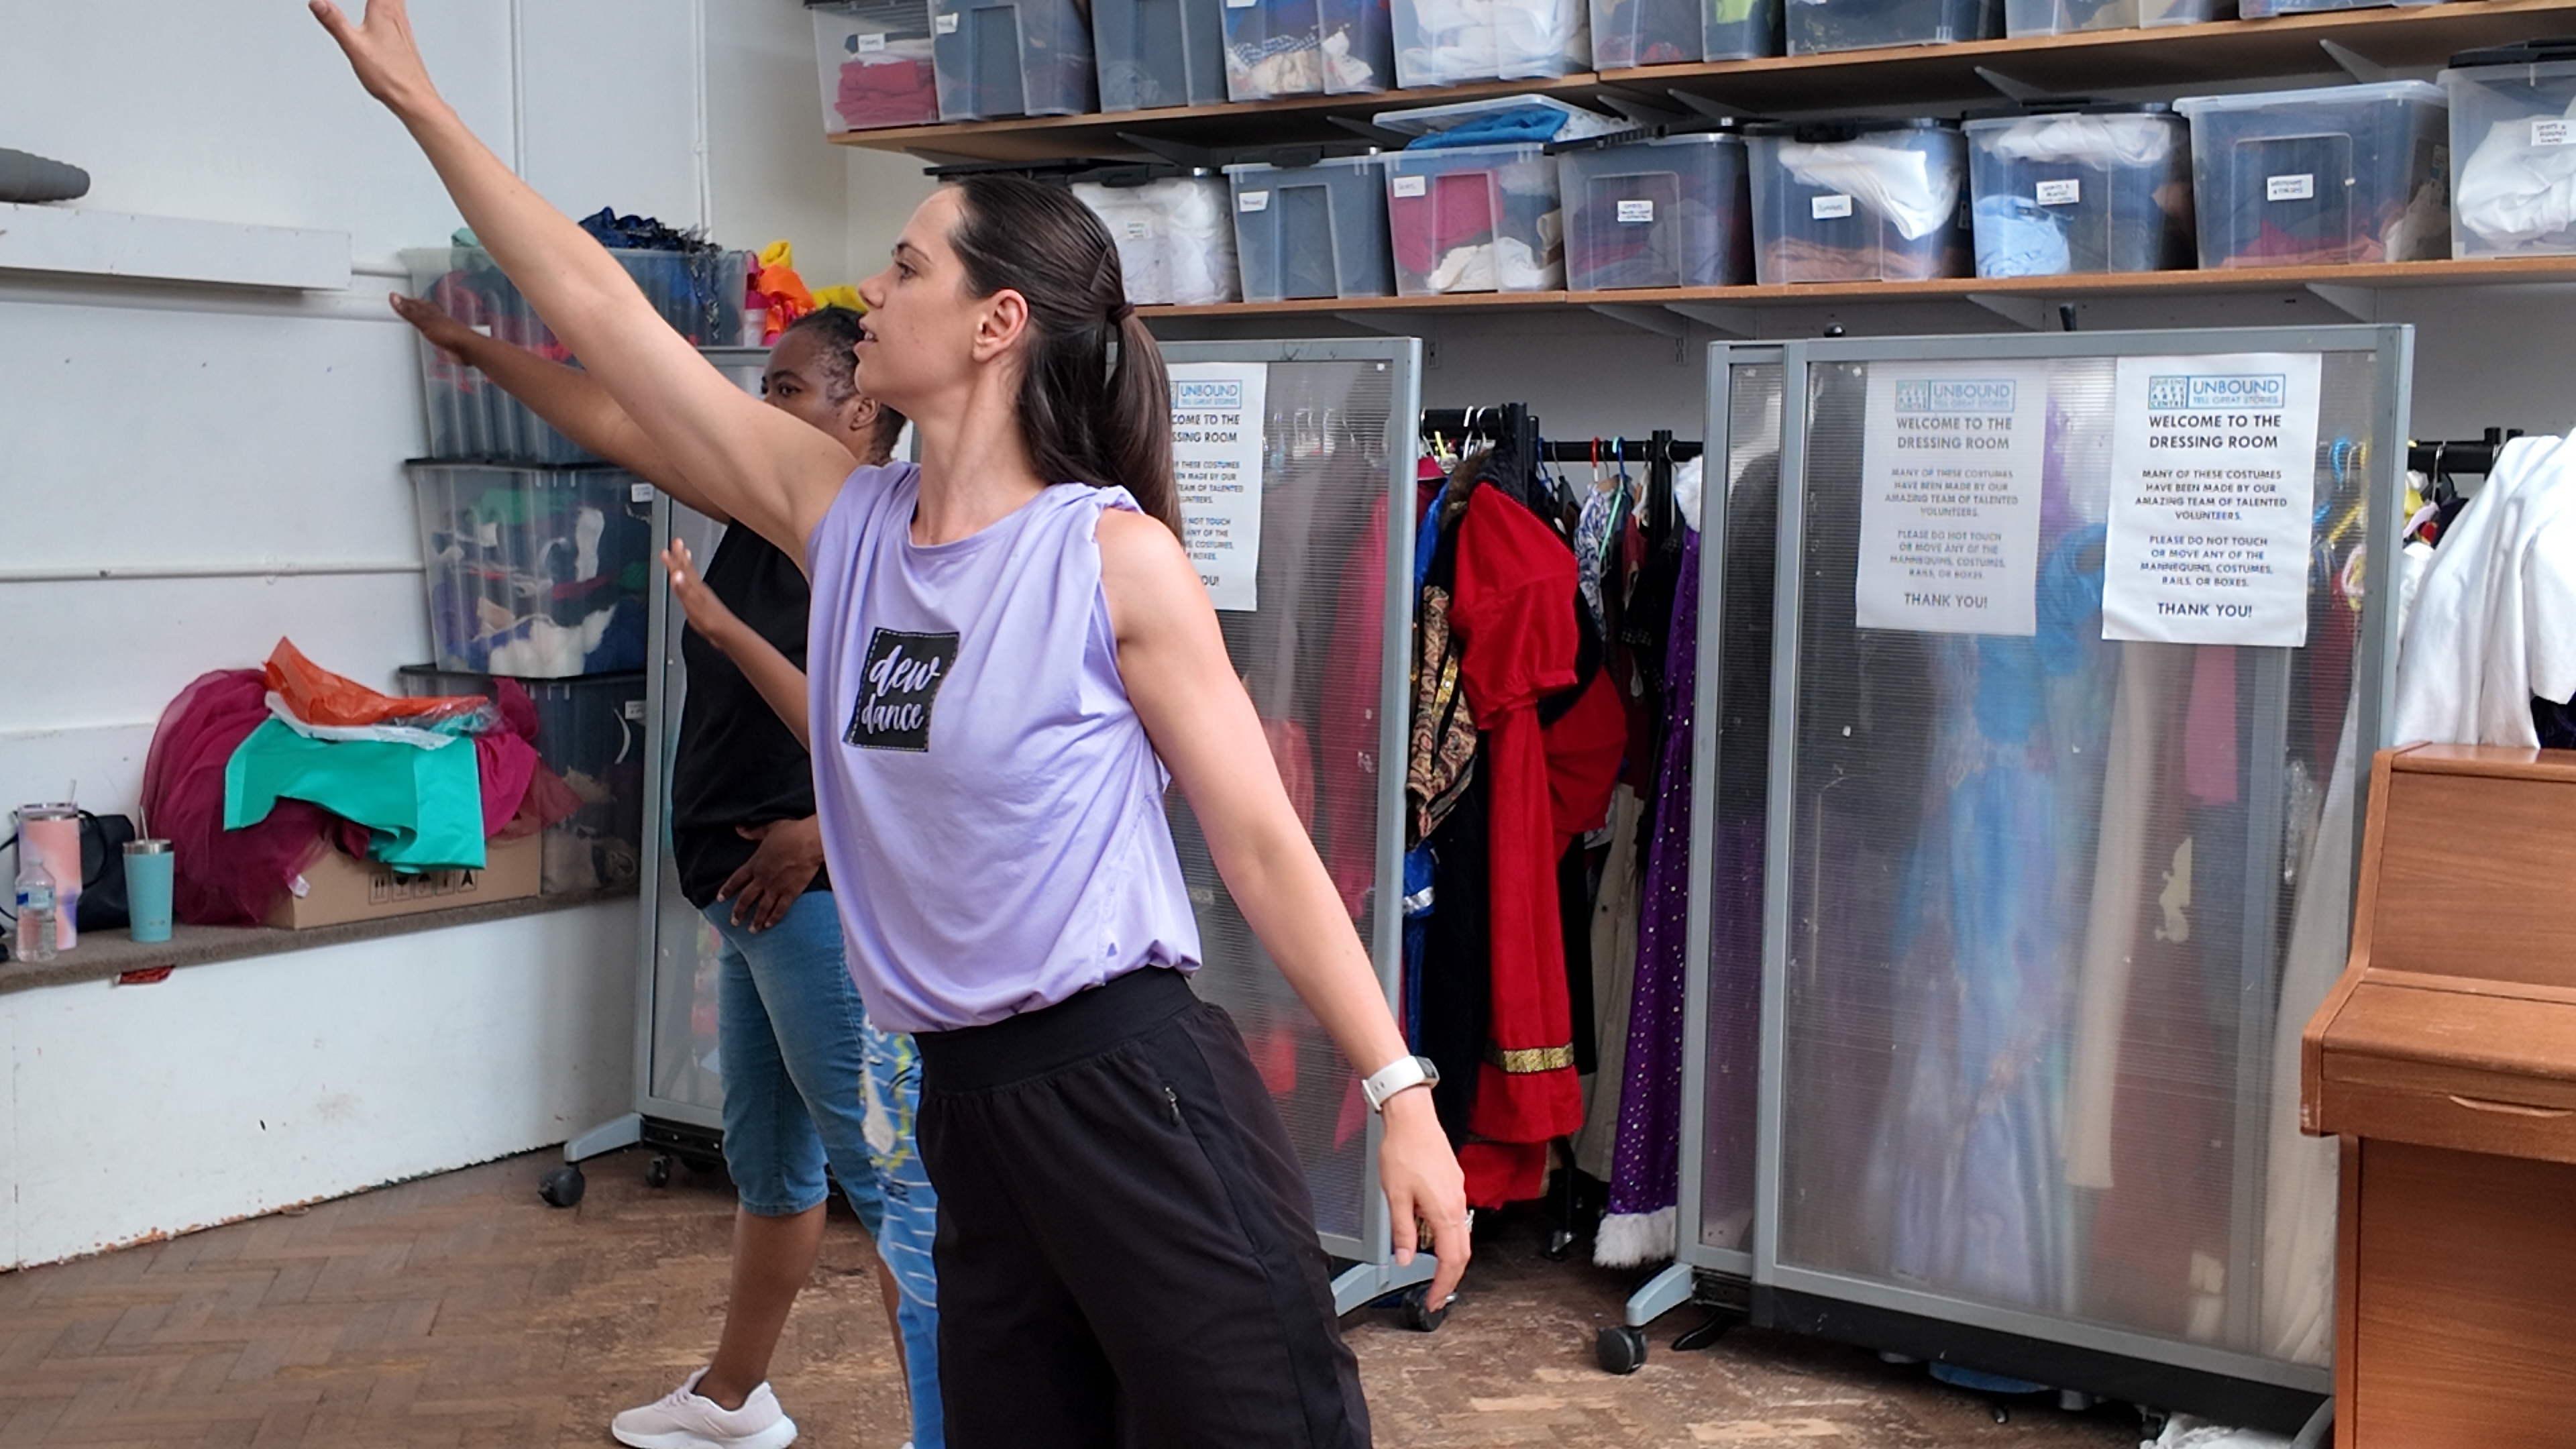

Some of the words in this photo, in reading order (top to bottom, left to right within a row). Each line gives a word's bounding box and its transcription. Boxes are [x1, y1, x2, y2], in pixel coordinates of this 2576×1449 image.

[1180, 385, 1237, 396] UNBOUND
[1934, 385, 2010, 397] UNBOUND
[2194, 380, 2279, 394] UNBOUND
[1172, 415, 1201, 425] COME
[1204, 415, 1218, 425] TO
[1222, 415, 1240, 425] THE
[1897, 418, 1960, 430] WELCOME
[1966, 418, 1983, 430] TO
[1987, 418, 2012, 430] THE
[2149, 415, 2222, 427] WELCOME
[2228, 415, 2247, 427] TO
[2254, 415, 2282, 427] THE
[1172, 432, 1201, 442] SSING
[1204, 432, 1237, 442] ROOM
[2150, 436, 2223, 448] DRESSING
[2229, 436, 2277, 448] ROOM
[1898, 437, 1962, 449] DRESSING
[1967, 437, 2009, 449] ROOM
[2142, 470, 2172, 479] MANY
[2176, 470, 2189, 479] OF
[2194, 470, 2222, 479] THESE
[2226, 470, 2282, 479] COSTUMES
[2147, 484, 2172, 493] HAVE
[2176, 484, 2199, 493] BEEN
[2204, 484, 2233, 493] MADE
[2237, 484, 2249, 493] BY
[2253, 484, 2276, 493] OUR
[2135, 498, 2184, 506] AMAZING
[2188, 498, 2214, 506] TEAM
[2218, 498, 2232, 506] OF
[2237, 498, 2287, 507] TALENTED
[2149, 537, 2184, 545] PLEASE
[2188, 537, 2203, 545] DO
[2207, 537, 2228, 545] NOT
[2233, 537, 2267, 545] TOUCH
[2151, 550, 2165, 559] OR
[2169, 550, 2199, 559] MOVE
[2203, 550, 2224, 559] ANY
[2229, 550, 2241, 559] OF
[2247, 550, 2264, 559] THE
[1201, 576, 1220, 586] OU!
[2196, 578, 2210, 586] OR
[1905, 593, 1951, 607] THANK
[1956, 596, 1988, 608] YOU!
[2157, 603, 2209, 616] THANK
[2216, 604, 2252, 618] YOU!
[869, 645, 941, 696] dew
[861, 694, 924, 734] dance
